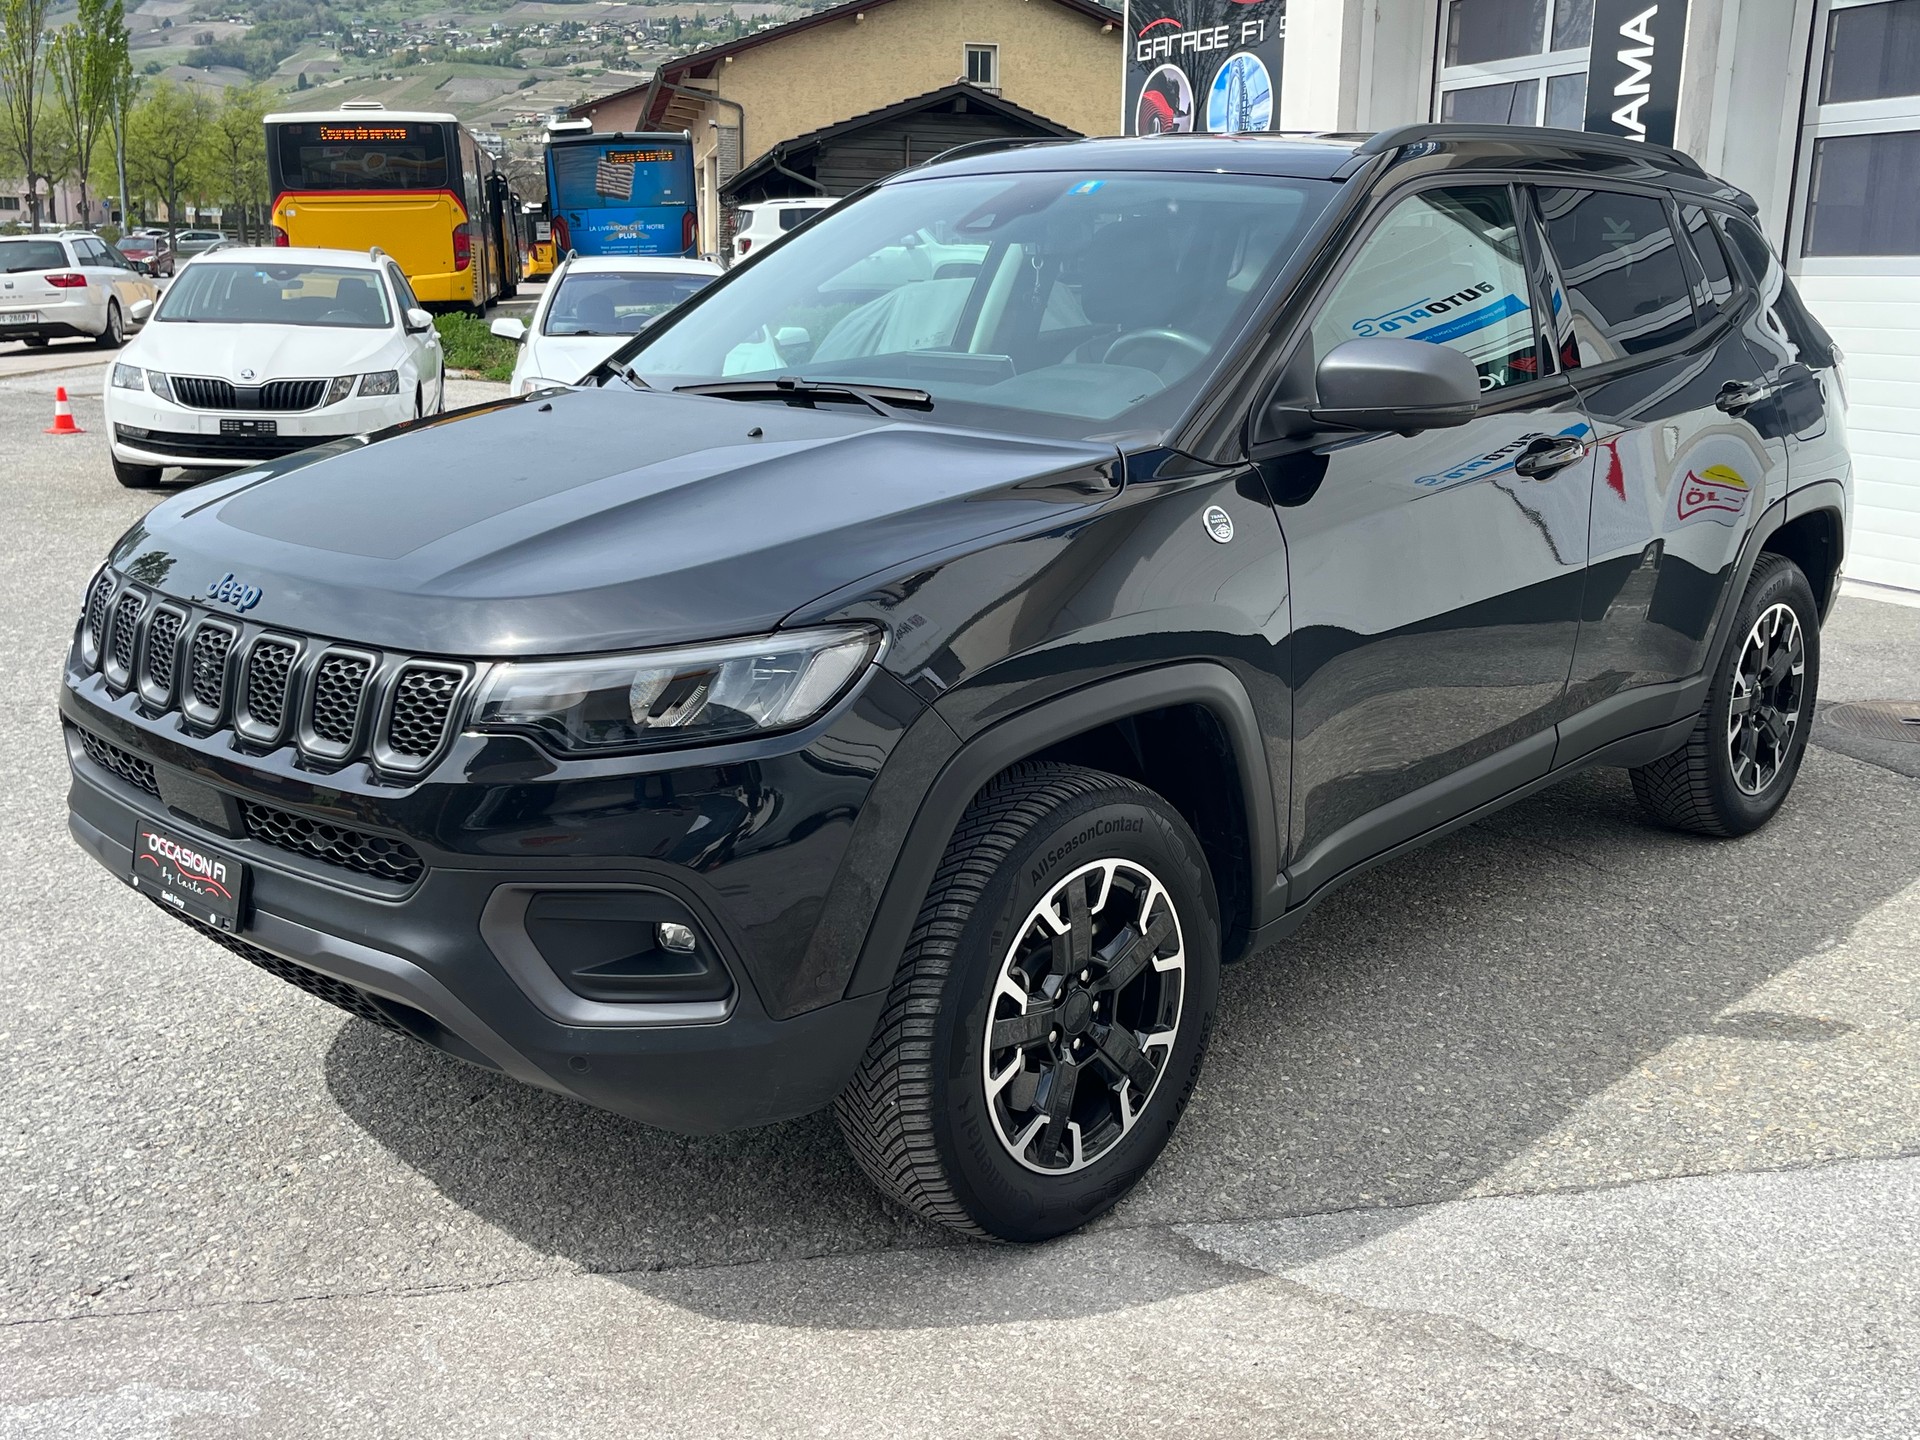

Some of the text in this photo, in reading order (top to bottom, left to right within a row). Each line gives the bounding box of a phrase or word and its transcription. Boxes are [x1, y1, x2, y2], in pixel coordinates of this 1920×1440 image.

[1137, 25, 1229, 62] GARAGE
[1241, 19, 1265, 45] F1
[1611, 4, 1658, 143] AMA
[597, 224, 628, 232] LIVRAISON
[206, 572, 263, 614] Jeep
[148, 833, 212, 878] OCCASION
[1030, 815, 1145, 888] AllSeasonContact
[161, 890, 185, 909] Emil Frey
